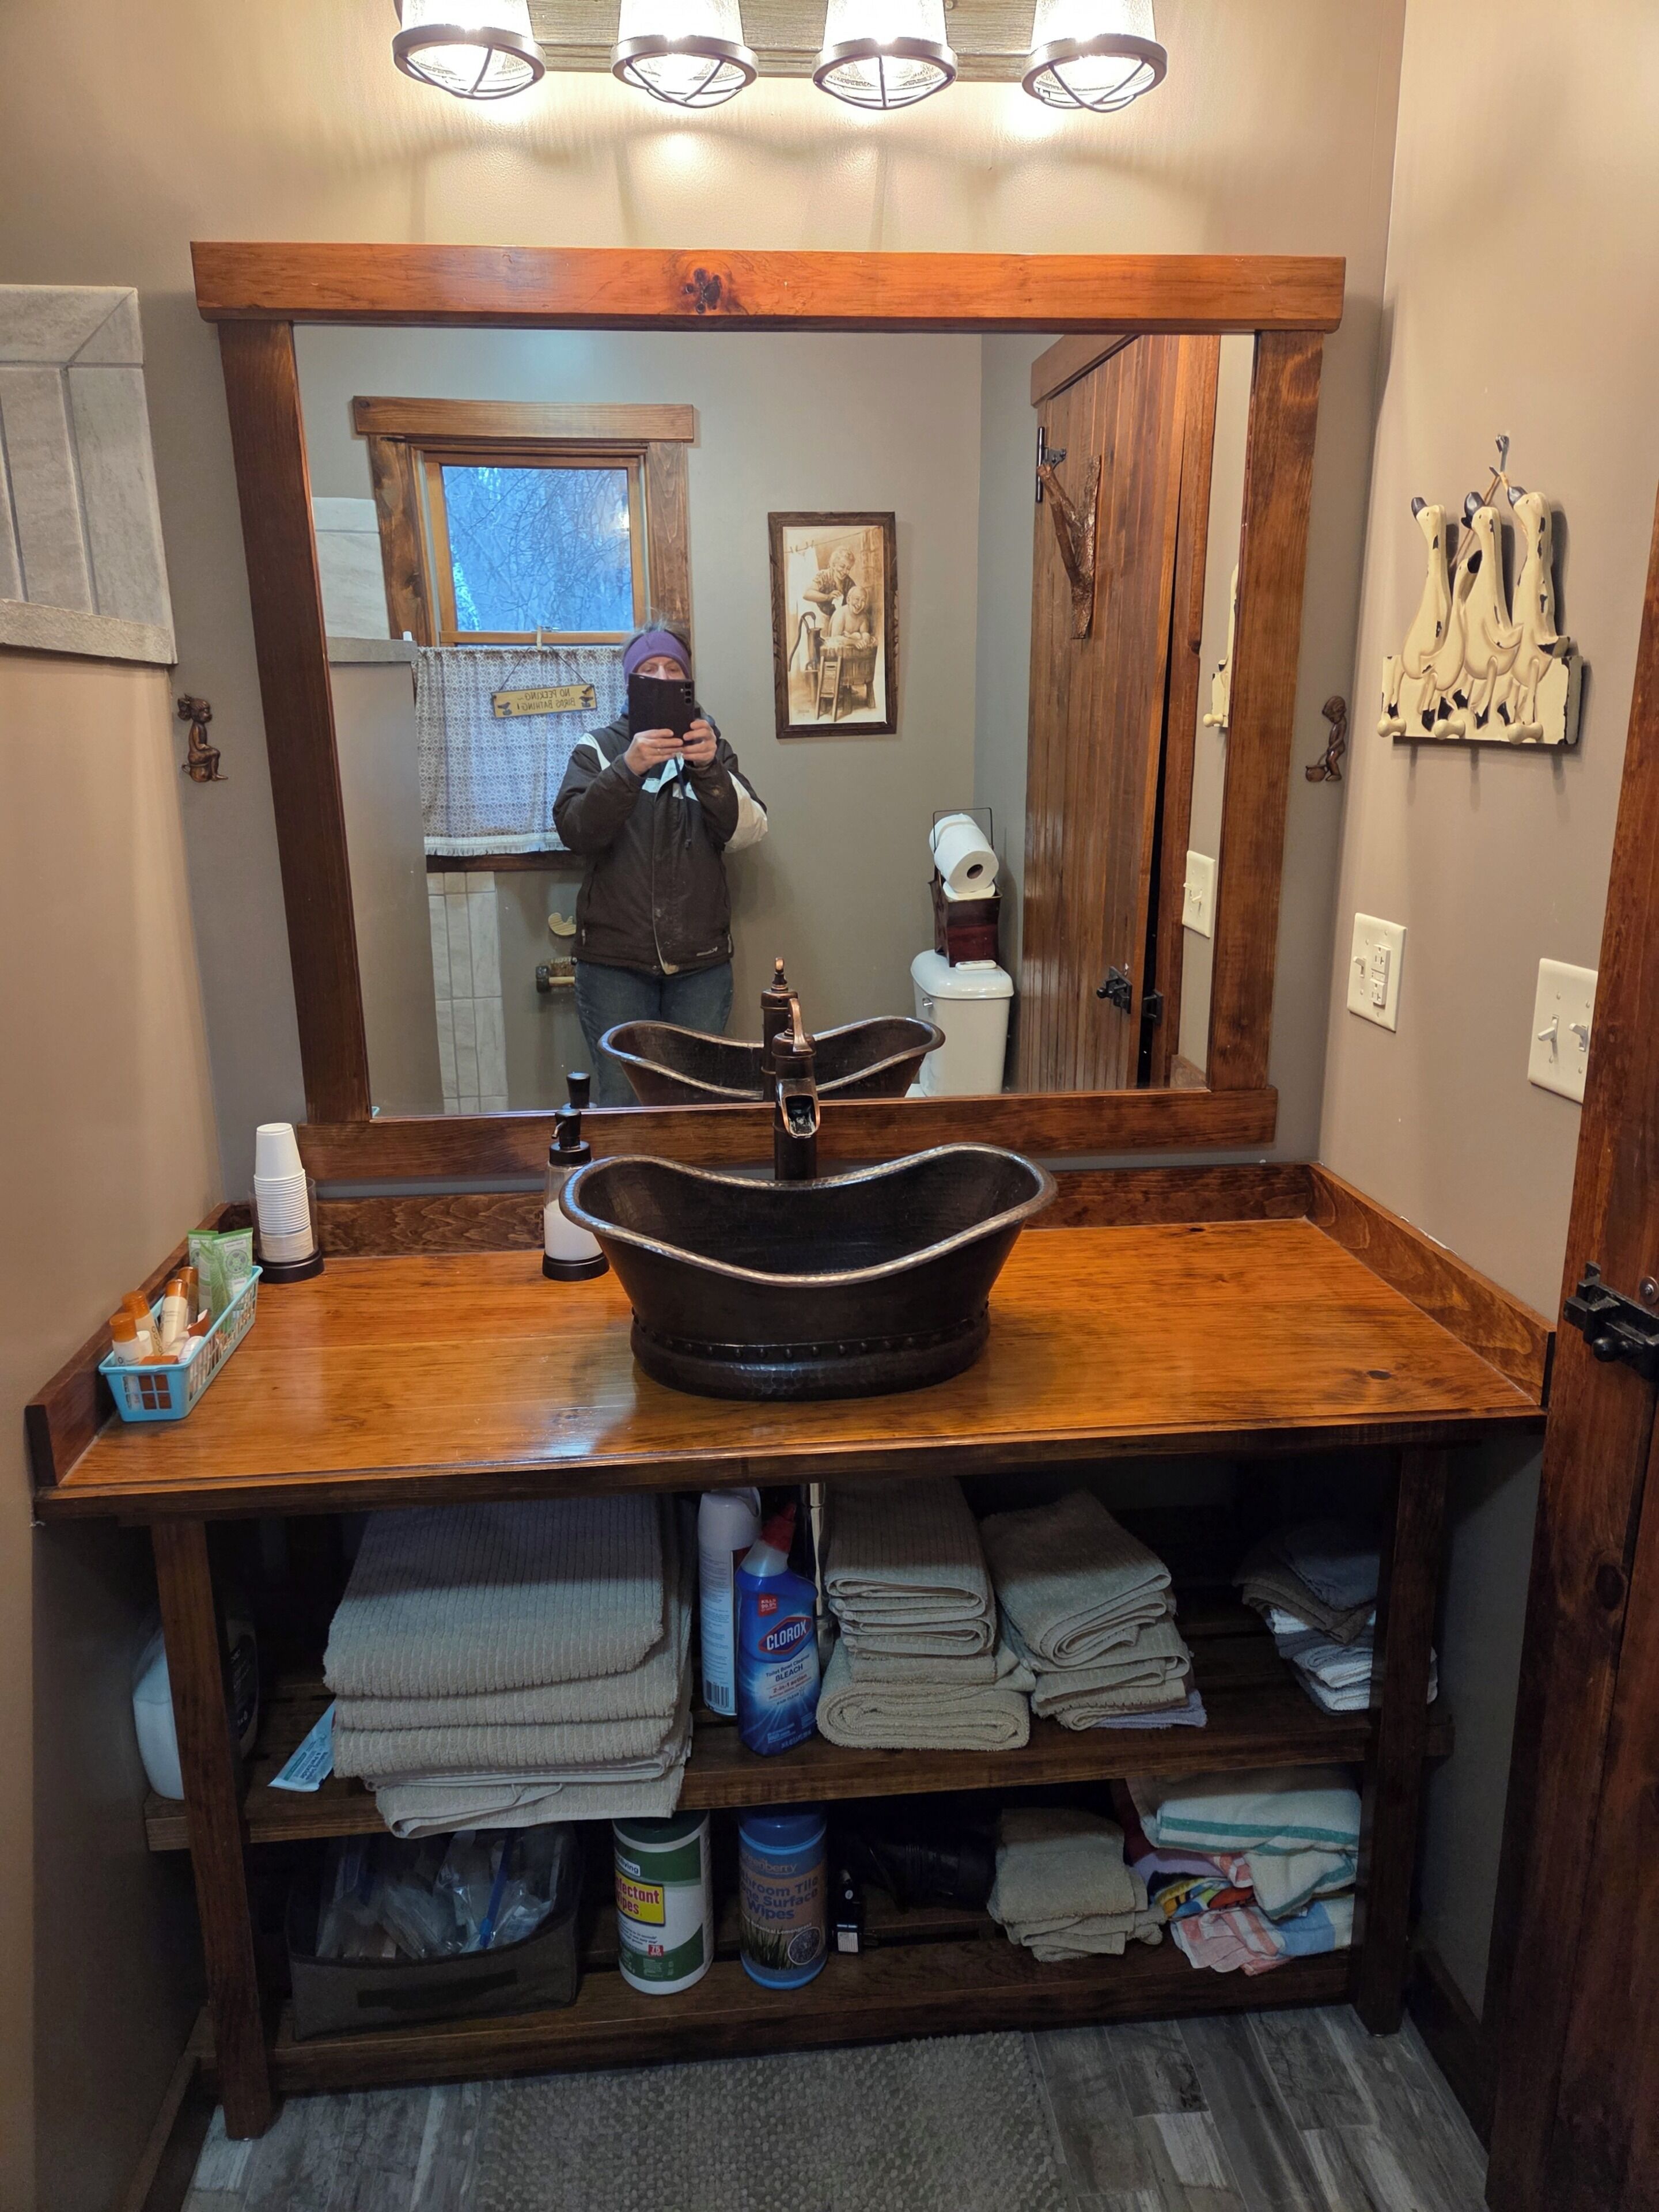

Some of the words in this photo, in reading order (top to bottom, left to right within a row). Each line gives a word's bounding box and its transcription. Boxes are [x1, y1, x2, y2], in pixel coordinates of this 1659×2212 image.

[767, 1619, 806, 1650] CLOROX
[766, 1668, 779, 1677] Toilet
[781, 1663, 792, 1671] Bowl
[775, 1663, 803, 1682] BLEACH
[772, 1681, 790, 1693] 2-in-1
[790, 1674, 807, 1685] action
[615, 1877, 660, 1904] fectant
[796, 1876, 819, 1893] Tile
[764, 1887, 819, 1908] Surface
[747, 1896, 795, 1920] Wipes
